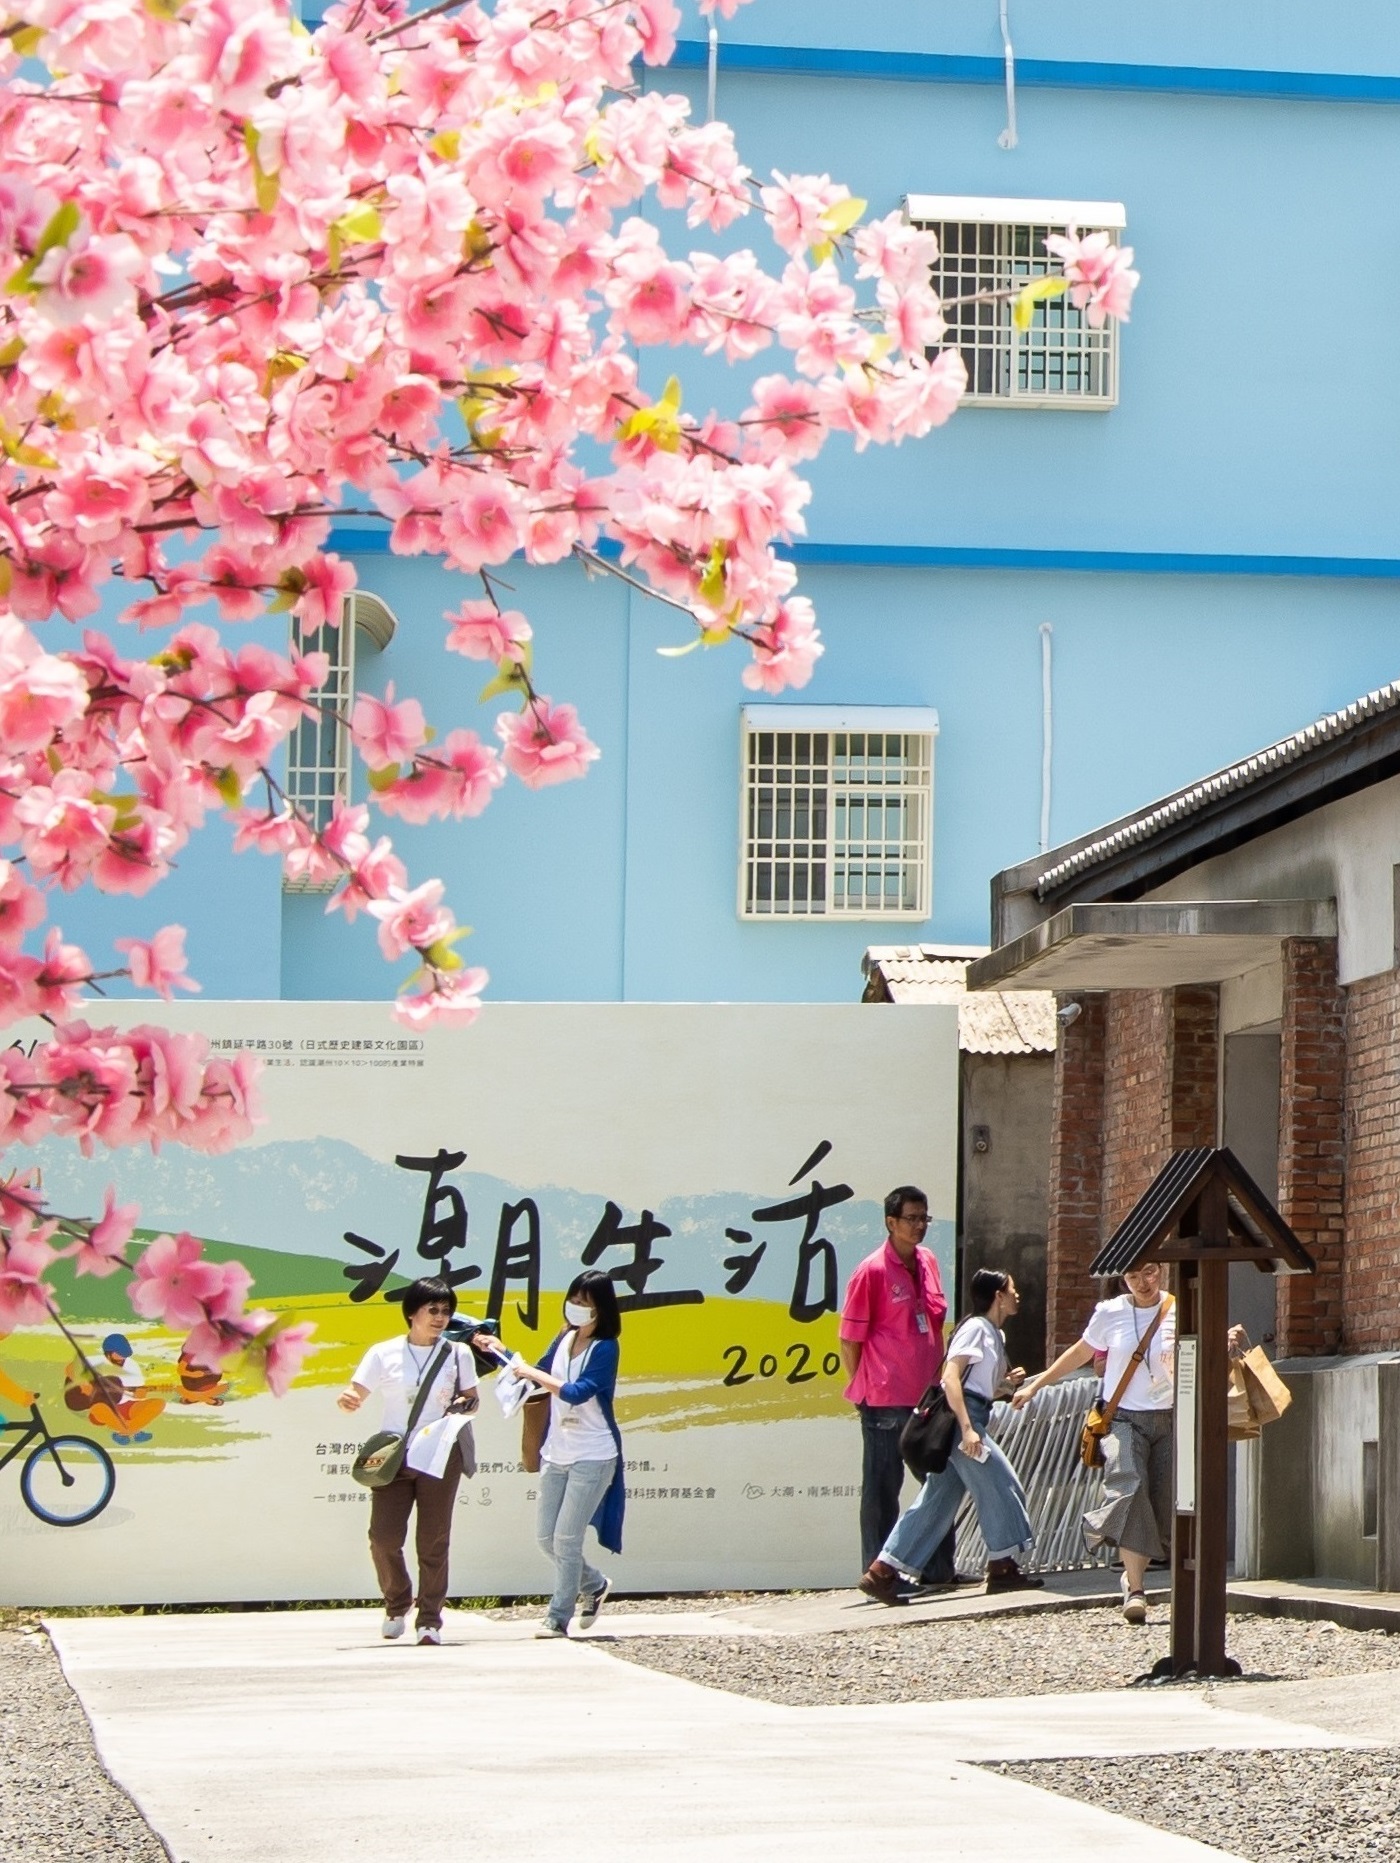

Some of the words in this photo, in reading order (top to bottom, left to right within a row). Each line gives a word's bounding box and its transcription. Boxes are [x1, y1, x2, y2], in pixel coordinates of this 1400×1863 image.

[343, 1140, 855, 1332] 潮生活
[722, 1343, 840, 1387] 2020
